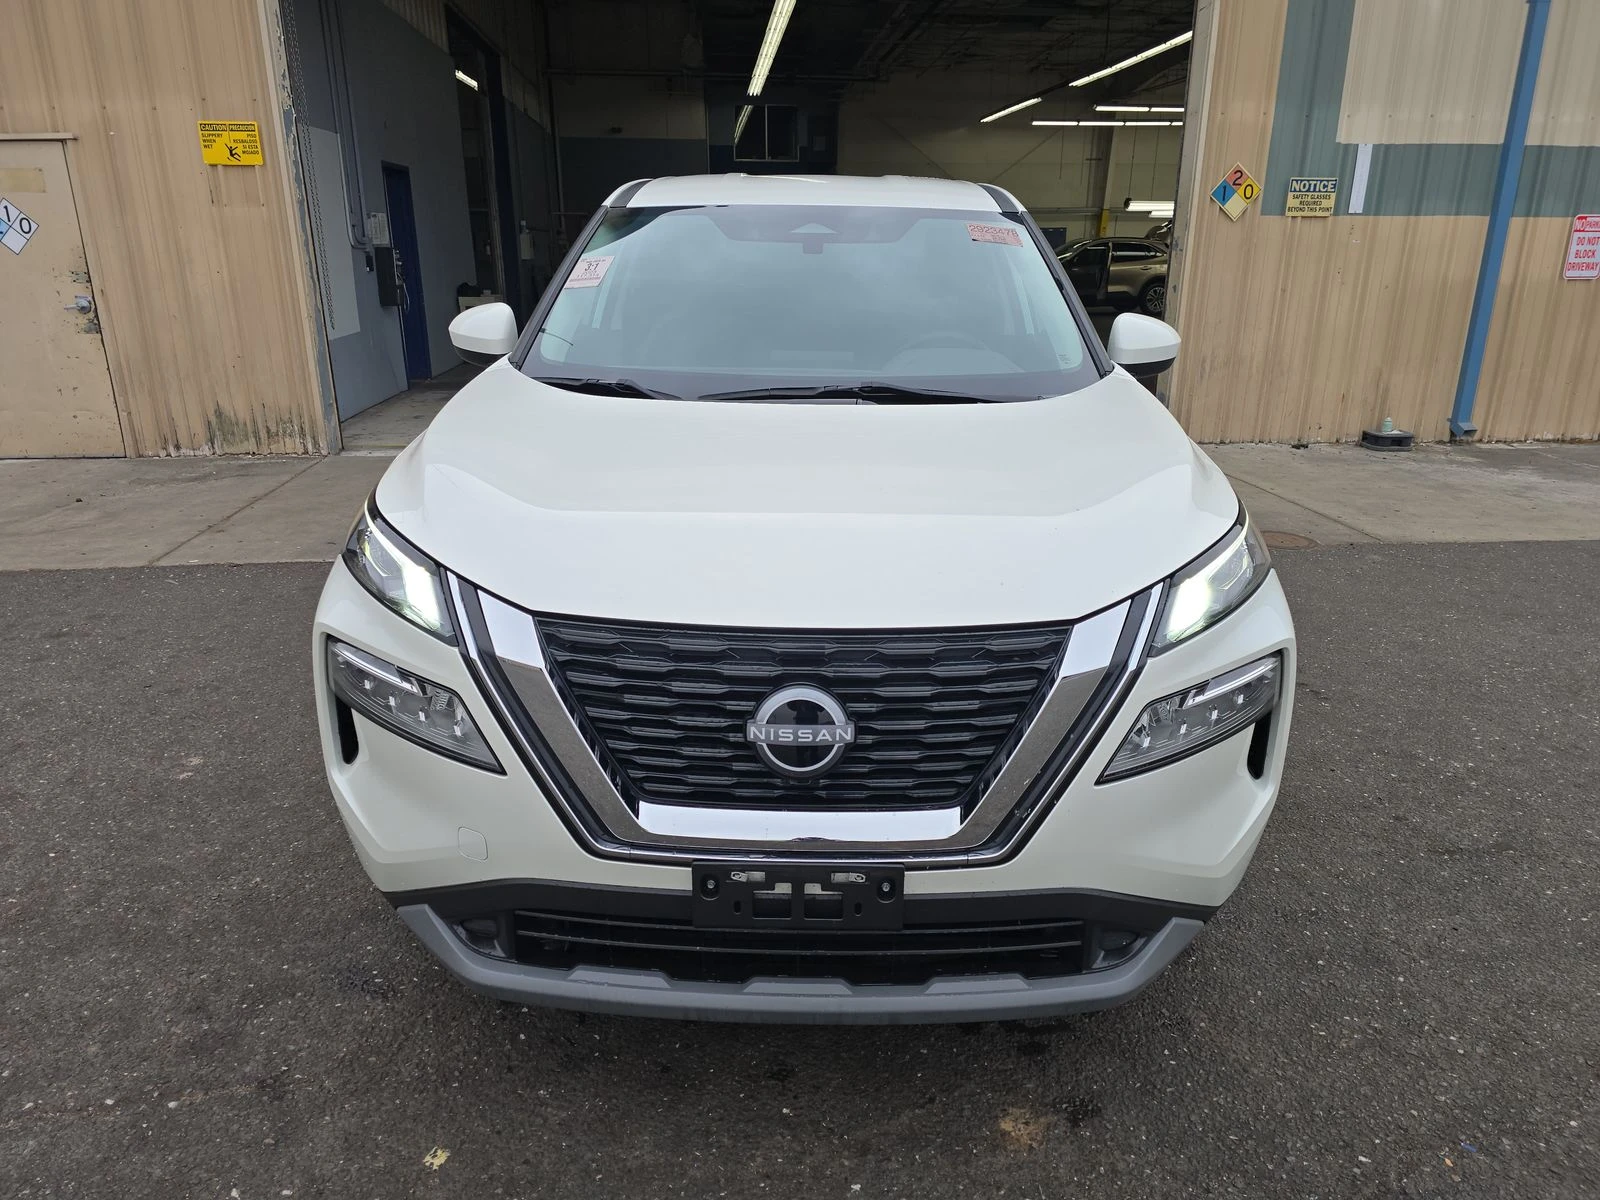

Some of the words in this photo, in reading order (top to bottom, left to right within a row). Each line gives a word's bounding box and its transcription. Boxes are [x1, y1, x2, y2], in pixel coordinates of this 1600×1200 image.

[1232, 170, 1243, 186] 2
[1291, 180, 1336, 192] NOTICE
[1222, 185, 1227, 202] 1
[1244, 184, 1254, 200] 0
[3, 205, 11, 223] 1
[20, 217, 31, 234] 0
[1575, 220, 1586, 230] NO
[1576, 236, 1585, 246] DO
[1588, 236, 1600, 246] NOT
[1575, 250, 1596, 258] BLOCK
[1568, 262, 1598, 270] DRIVEWAY
[750, 726, 852, 742] NISSAN
